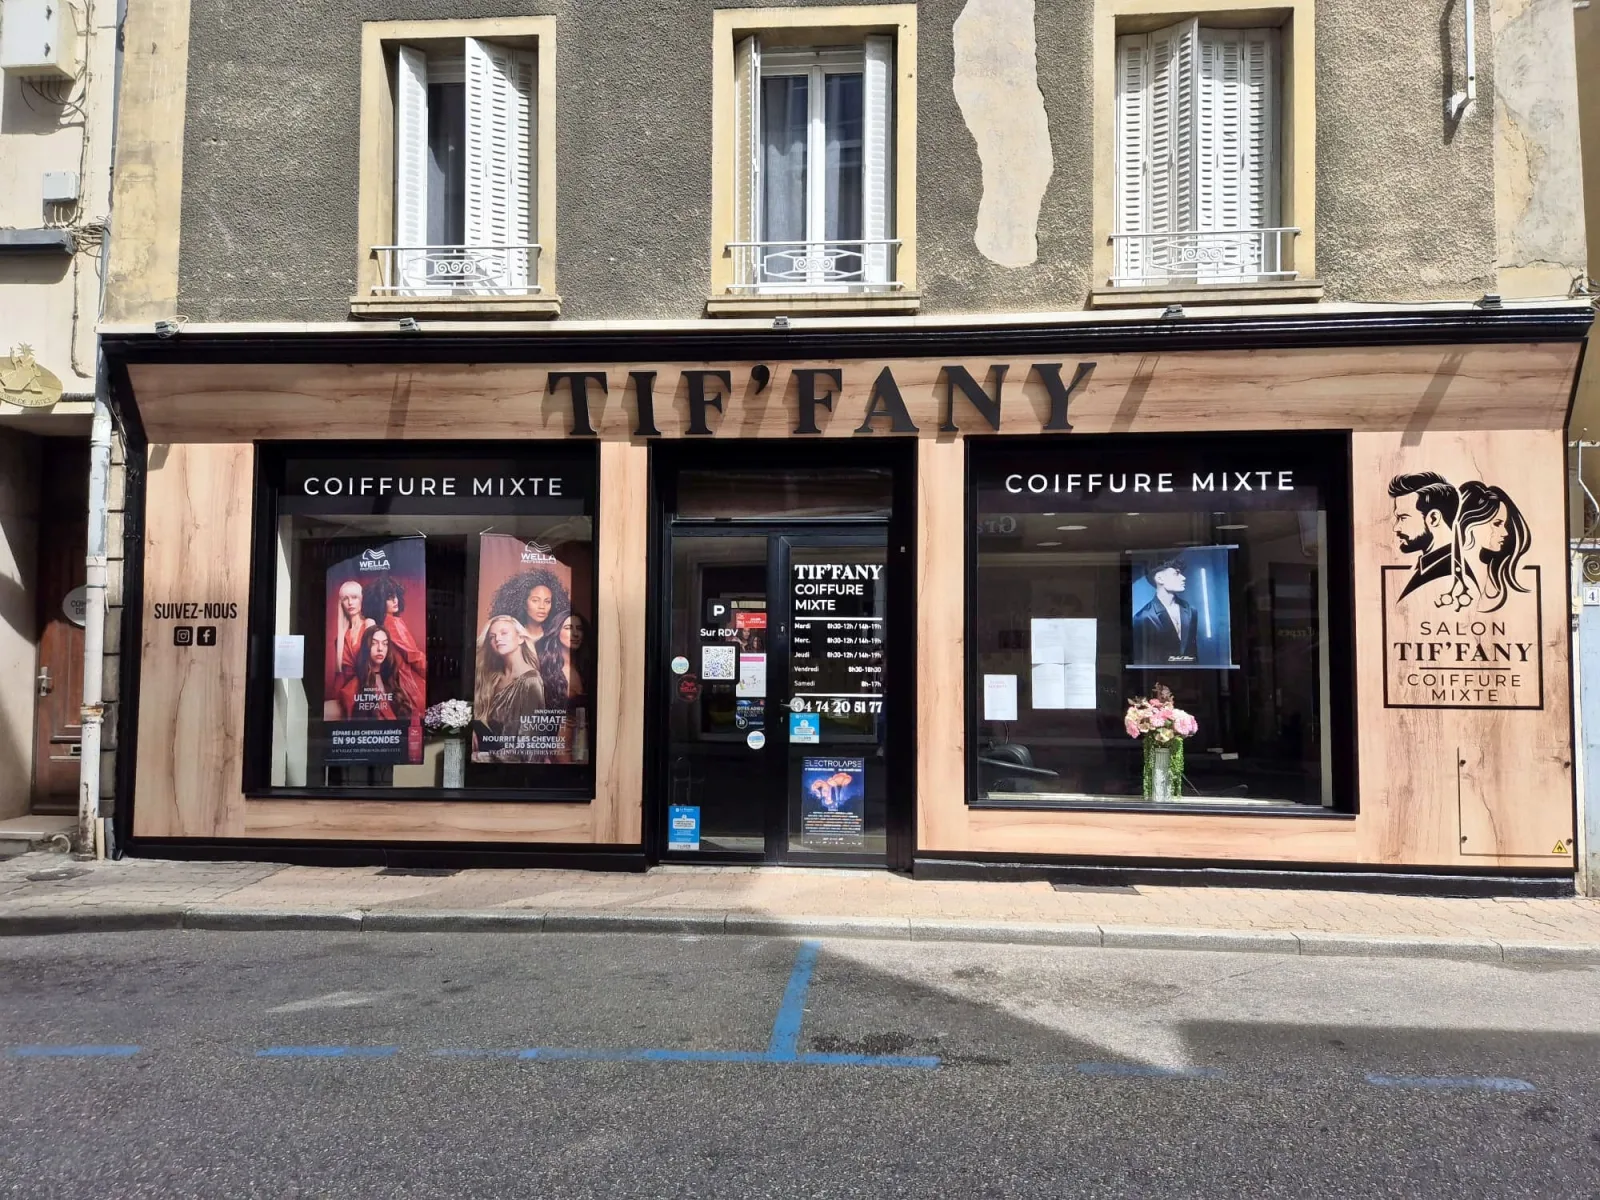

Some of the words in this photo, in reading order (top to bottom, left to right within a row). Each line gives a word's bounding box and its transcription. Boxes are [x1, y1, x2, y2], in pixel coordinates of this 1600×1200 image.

[547, 361, 1097, 436] TIF'FANY
[303, 477, 456, 496] COIFFURE
[472, 477, 563, 496] MIXTE
[1004, 472, 1174, 493] COIFFURE
[1191, 470, 1295, 491] MIXTE
[521, 552, 557, 561] WELLA
[359, 559, 390, 568] WELLA
[794, 563, 884, 580] TIF'FANY
[794, 583, 864, 596] COIFFURE
[1588, 591, 1596, 602] 4
[154, 602, 238, 619] SUIVEZ-NOUS
[795, 599, 837, 611] MIXTE
[794, 622, 812, 630] Mardi
[1420, 621, 1506, 636] SALON
[700, 628, 716, 637] Sur
[717, 628, 739, 637] RDV
[1393, 641, 1533, 662] TIF'FANY
[794, 665, 820, 673] Vendredi
[1407, 673, 1522, 687] COIFFURE
[353, 693, 393, 702] ULTIMATE
[1431, 688, 1499, 702] MIXTE
[358, 702, 388, 711] REPAIR
[815, 701, 830, 713] 74
[833, 701, 851, 713] 20
[868, 701, 883, 714] 77
[520, 715, 567, 724] ULTIMATE
[523, 723, 567, 732] SMOOTH
[332, 736, 344, 745] EN
[345, 736, 356, 744] 90
[357, 735, 400, 744] SECONDES
[531, 735, 566, 743] CHEVEUX
